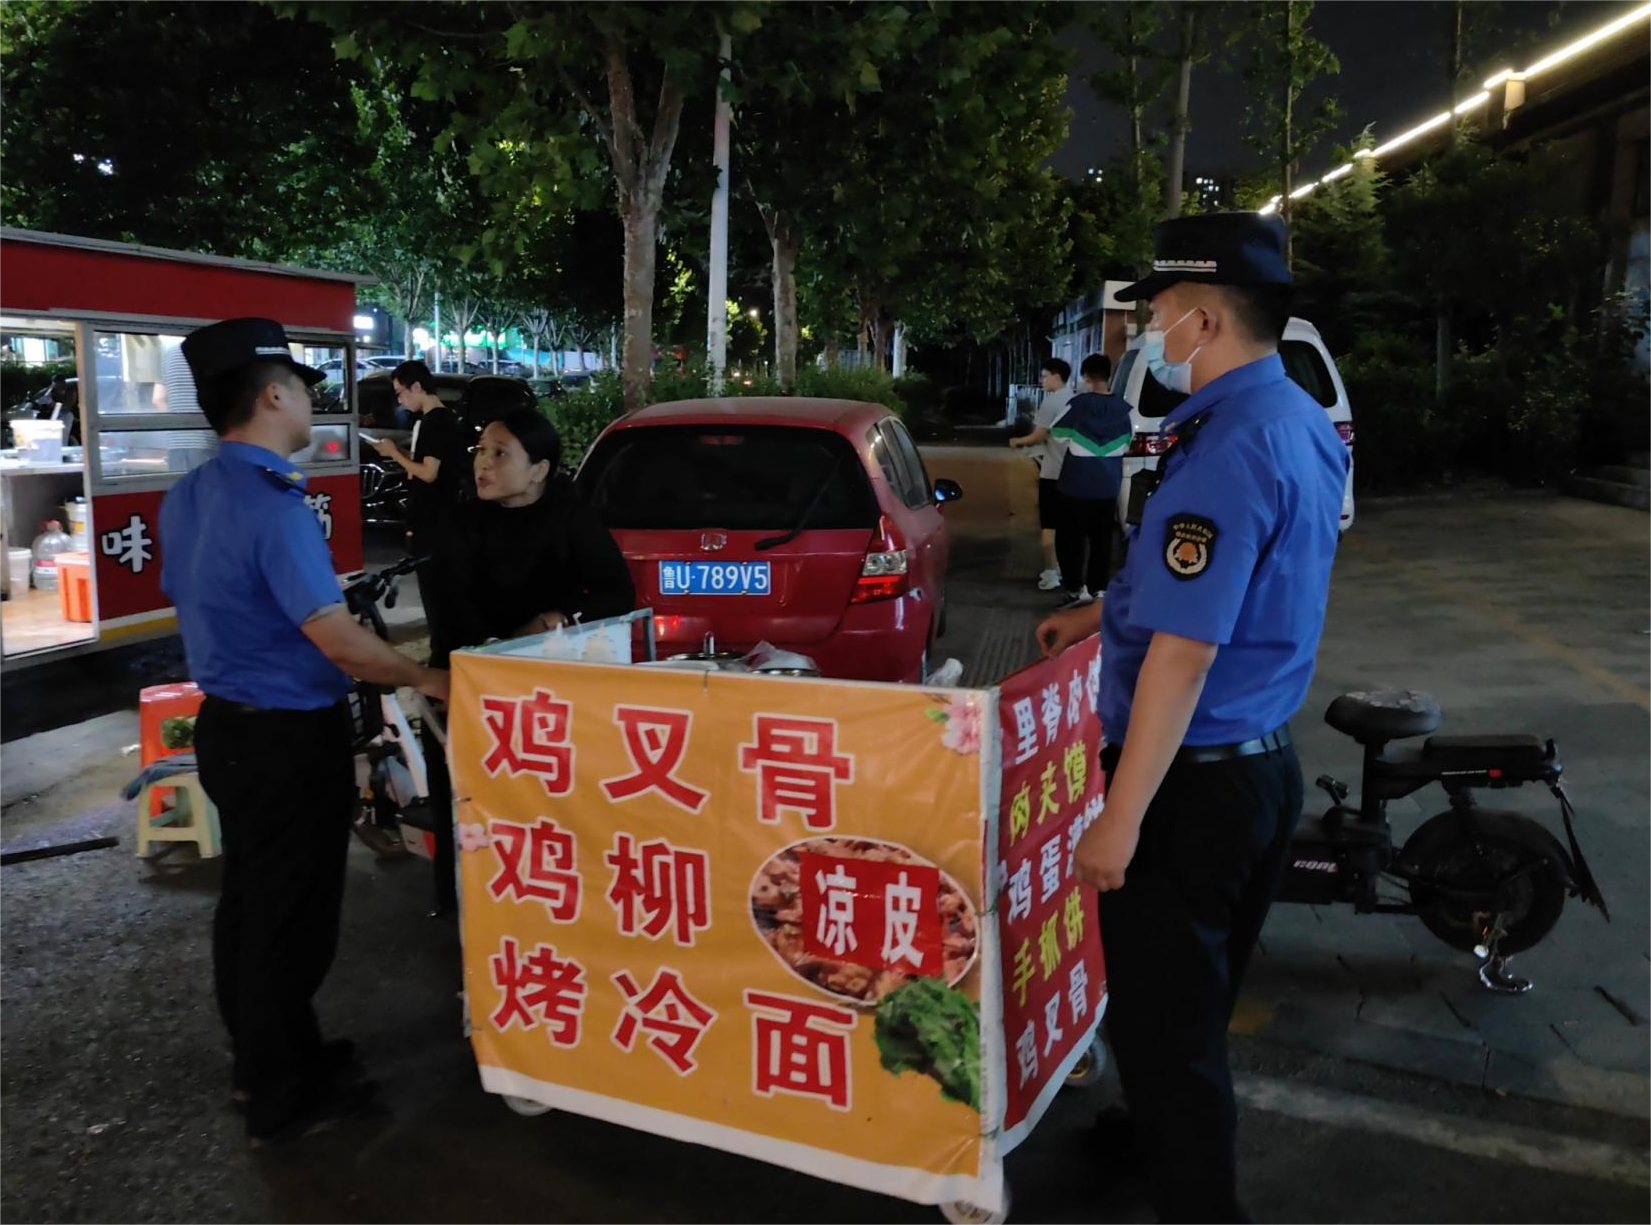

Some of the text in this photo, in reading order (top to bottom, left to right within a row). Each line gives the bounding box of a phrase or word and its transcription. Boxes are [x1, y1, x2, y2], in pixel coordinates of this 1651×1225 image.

[101, 514, 154, 573] 味
[1009, 738, 1087, 847] 肉夹馍
[814, 863, 925, 968] 凉皮
[1012, 884, 1085, 1008] 手抓饼
[488, 936, 859, 1113] 烤冷面
